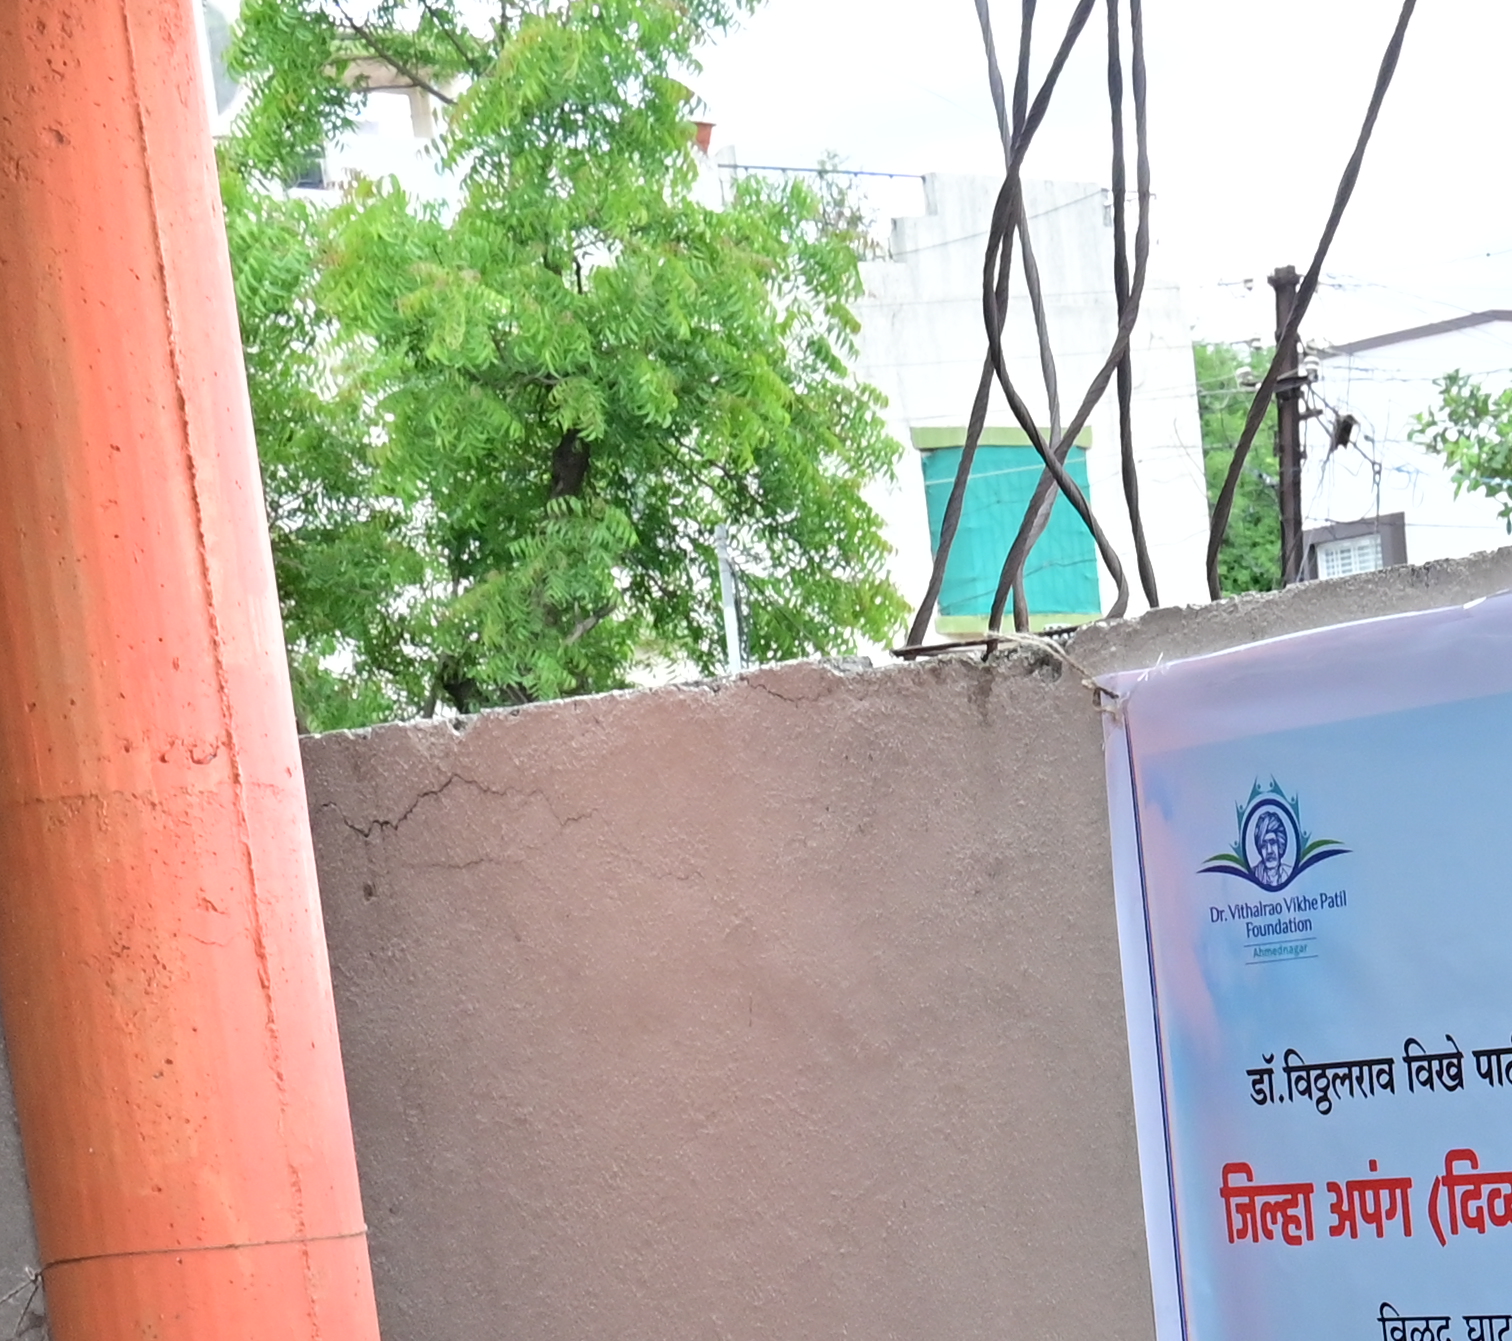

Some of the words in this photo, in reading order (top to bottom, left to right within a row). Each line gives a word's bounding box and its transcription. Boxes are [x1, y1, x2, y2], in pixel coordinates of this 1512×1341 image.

[1209, 906, 1228, 923] Dr.
[1228, 901, 1282, 920] Vithalrao
[1283, 895, 1318, 914] Vikhe
[1319, 890, 1347, 909] Patil
[1246, 918, 1312, 938] Foundation
[1253, 944, 1308, 959] Ahmednagar
[1403, 1034, 1464, 1095] विखे
[1219, 1161, 1314, 1246] जिल्हा
[1326, 1158, 1412, 1240] अपंग
